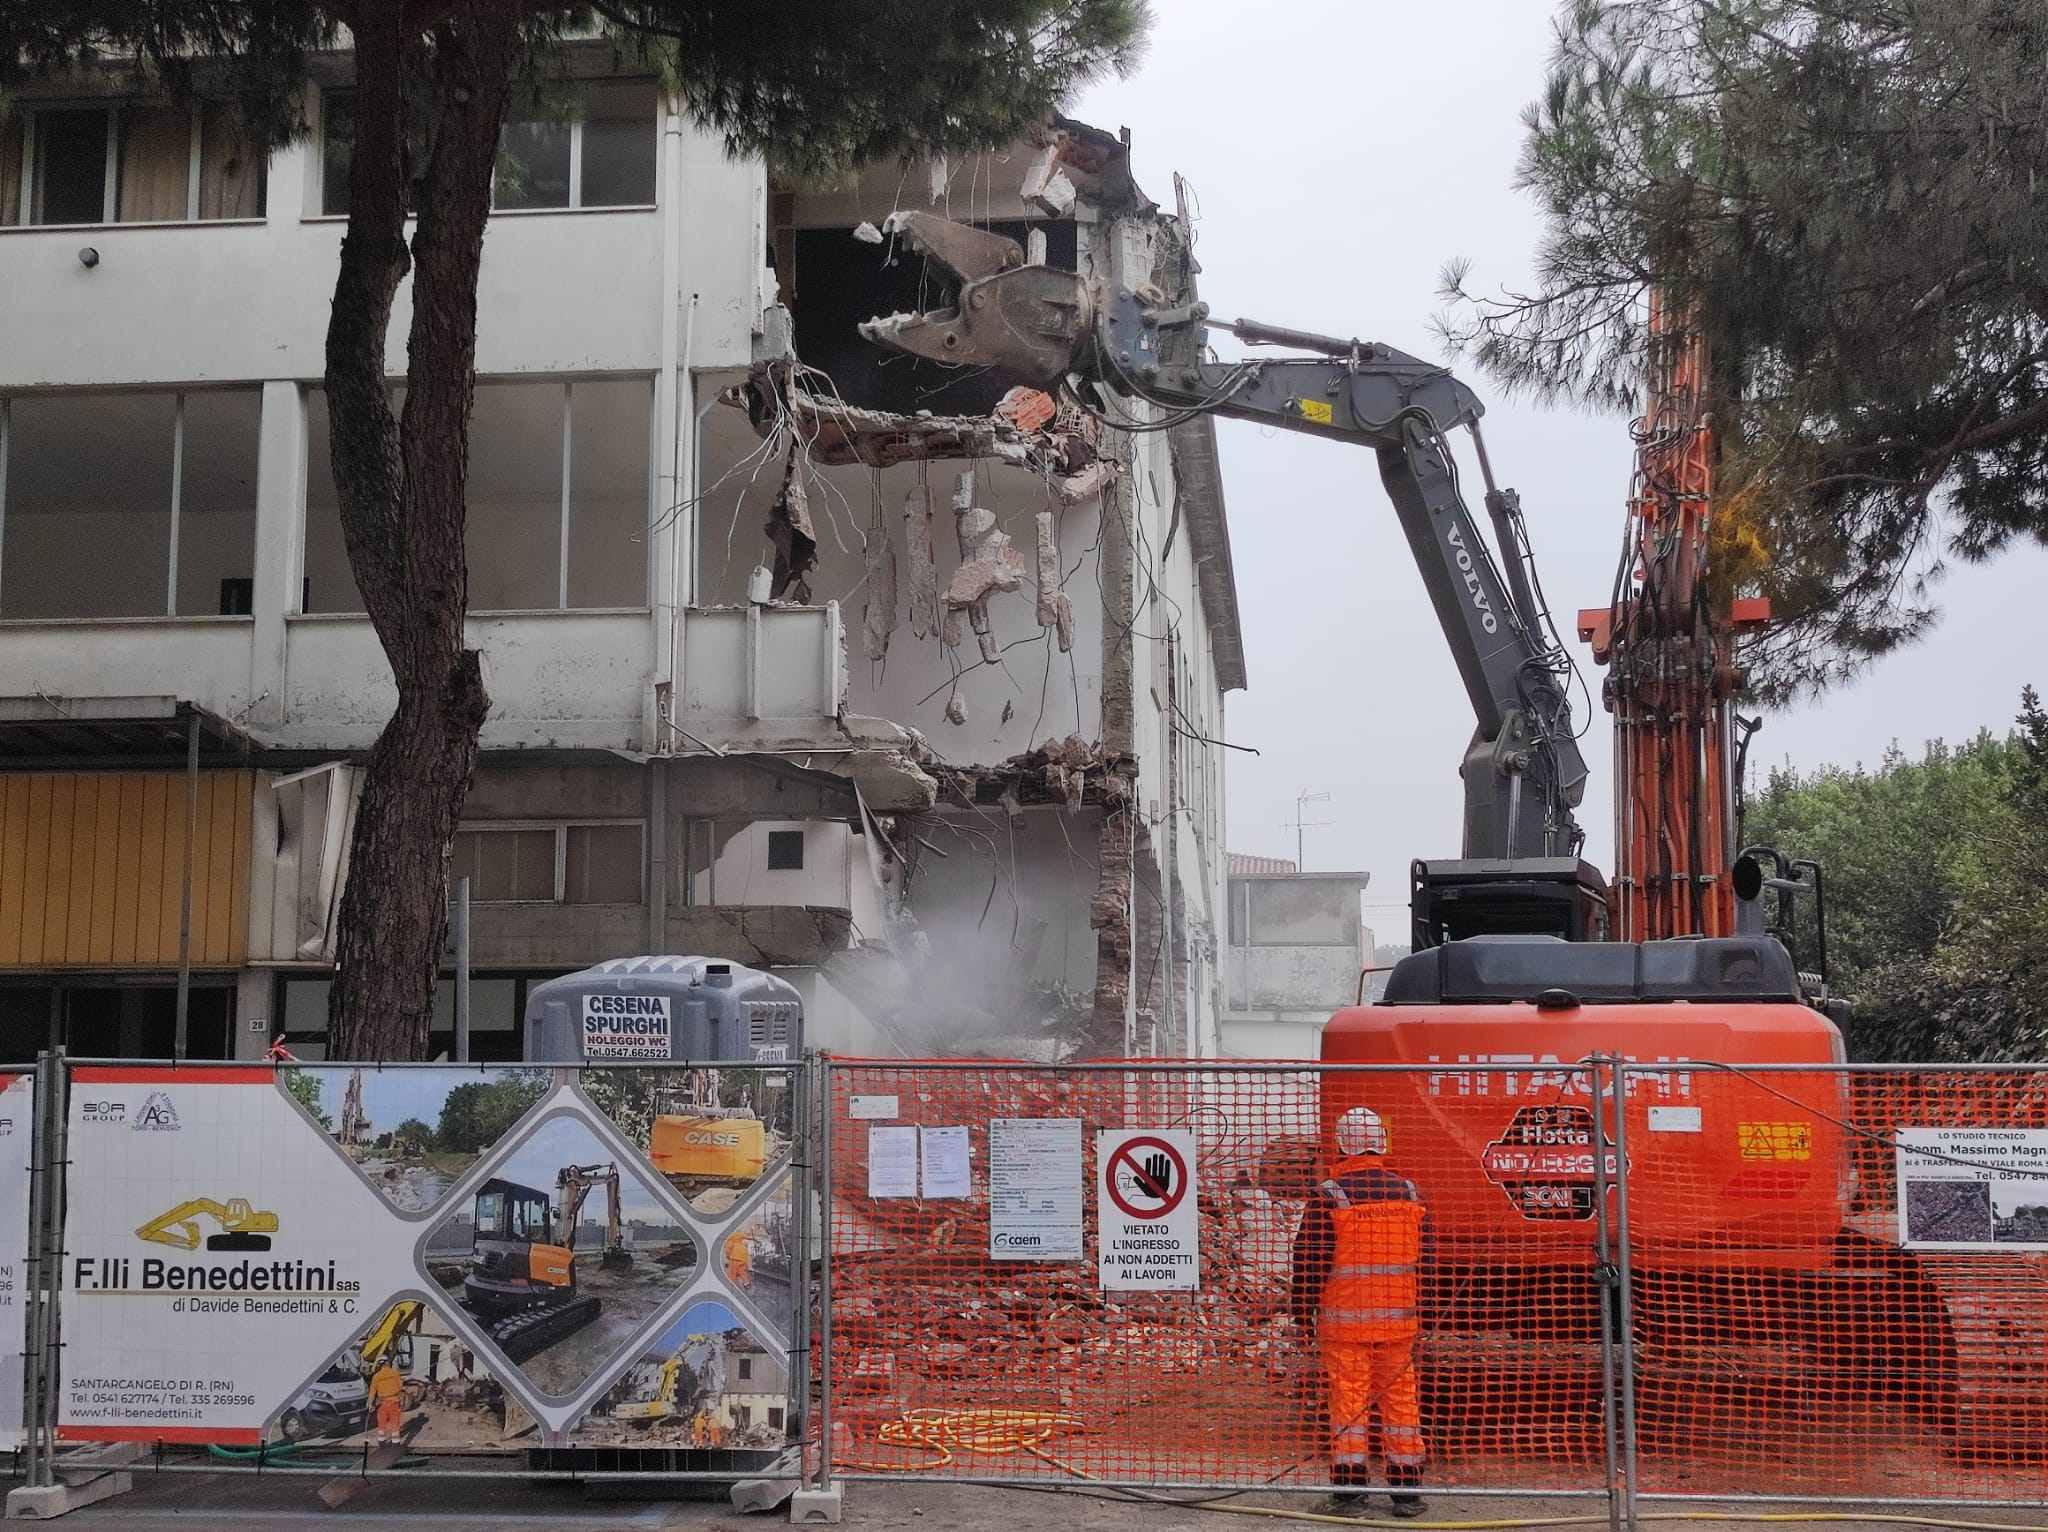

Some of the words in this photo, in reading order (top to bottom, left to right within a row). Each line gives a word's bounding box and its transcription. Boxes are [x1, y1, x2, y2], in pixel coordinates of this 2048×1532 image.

[1447, 521, 1497, 634] VOLVO
[589, 996, 664, 1015] CESENA
[585, 1016, 667, 1035] SPURGHI
[587, 1035, 646, 1046] NOLEGGIO
[648, 1037, 667, 1046] WC
[587, 1047, 668, 1058] Tel.0547.662522
[1428, 1055, 1690, 1098] HITACHI
[83, 1101, 126, 1114] SOA
[684, 1131, 740, 1146] CASE
[1952, 1132, 1986, 1140] STUDIO
[1950, 1145, 2008, 1155] Massimo
[2012, 1145, 2048, 1157] Magn
[1492, 1153, 1618, 1174] NOLEGGO
[1975, 1171, 1996, 1180] Tel.
[1999, 1171, 2028, 1181] 0547
[2031, 1172, 2048, 1181] 84
[1123, 1224, 1169, 1235] VIETATO
[1008, 1236, 1041, 1246] caem
[1112, 1239, 1180, 1250] L'INGRESSO
[1103, 1254, 1115, 1265] AI
[1117, 1254, 1142, 1265] NON
[1144, 1254, 1193, 1265] ADDETTI
[74, 1258, 129, 1290] F.lli
[142, 1258, 336, 1291] Benedettini
[336, 1278, 361, 1292] sas
[1120, 1269, 1132, 1280] AI
[1135, 1269, 1176, 1280] LAVORI
[173, 1297, 185, 1312] di
[190, 1297, 239, 1313] Davide
[244, 1298, 324, 1314] Benedettini
[328, 1299, 338, 1314] &
[343, 1299, 359, 1314] C.
[71, 1378, 177, 1391] SANTARCANGELO
[179, 1380, 192, 1391] DI
[195, 1380, 207, 1391] R.
[209, 1380, 234, 1393] (RN)
[70, 1392, 88, 1404] Tel.
[92, 1393, 119, 1404] 0541
[120, 1393, 159, 1405] 627174
[168, 1394, 188, 1405] Tel.
[191, 1394, 211, 1406] 335
[213, 1395, 256, 1407] 269596
